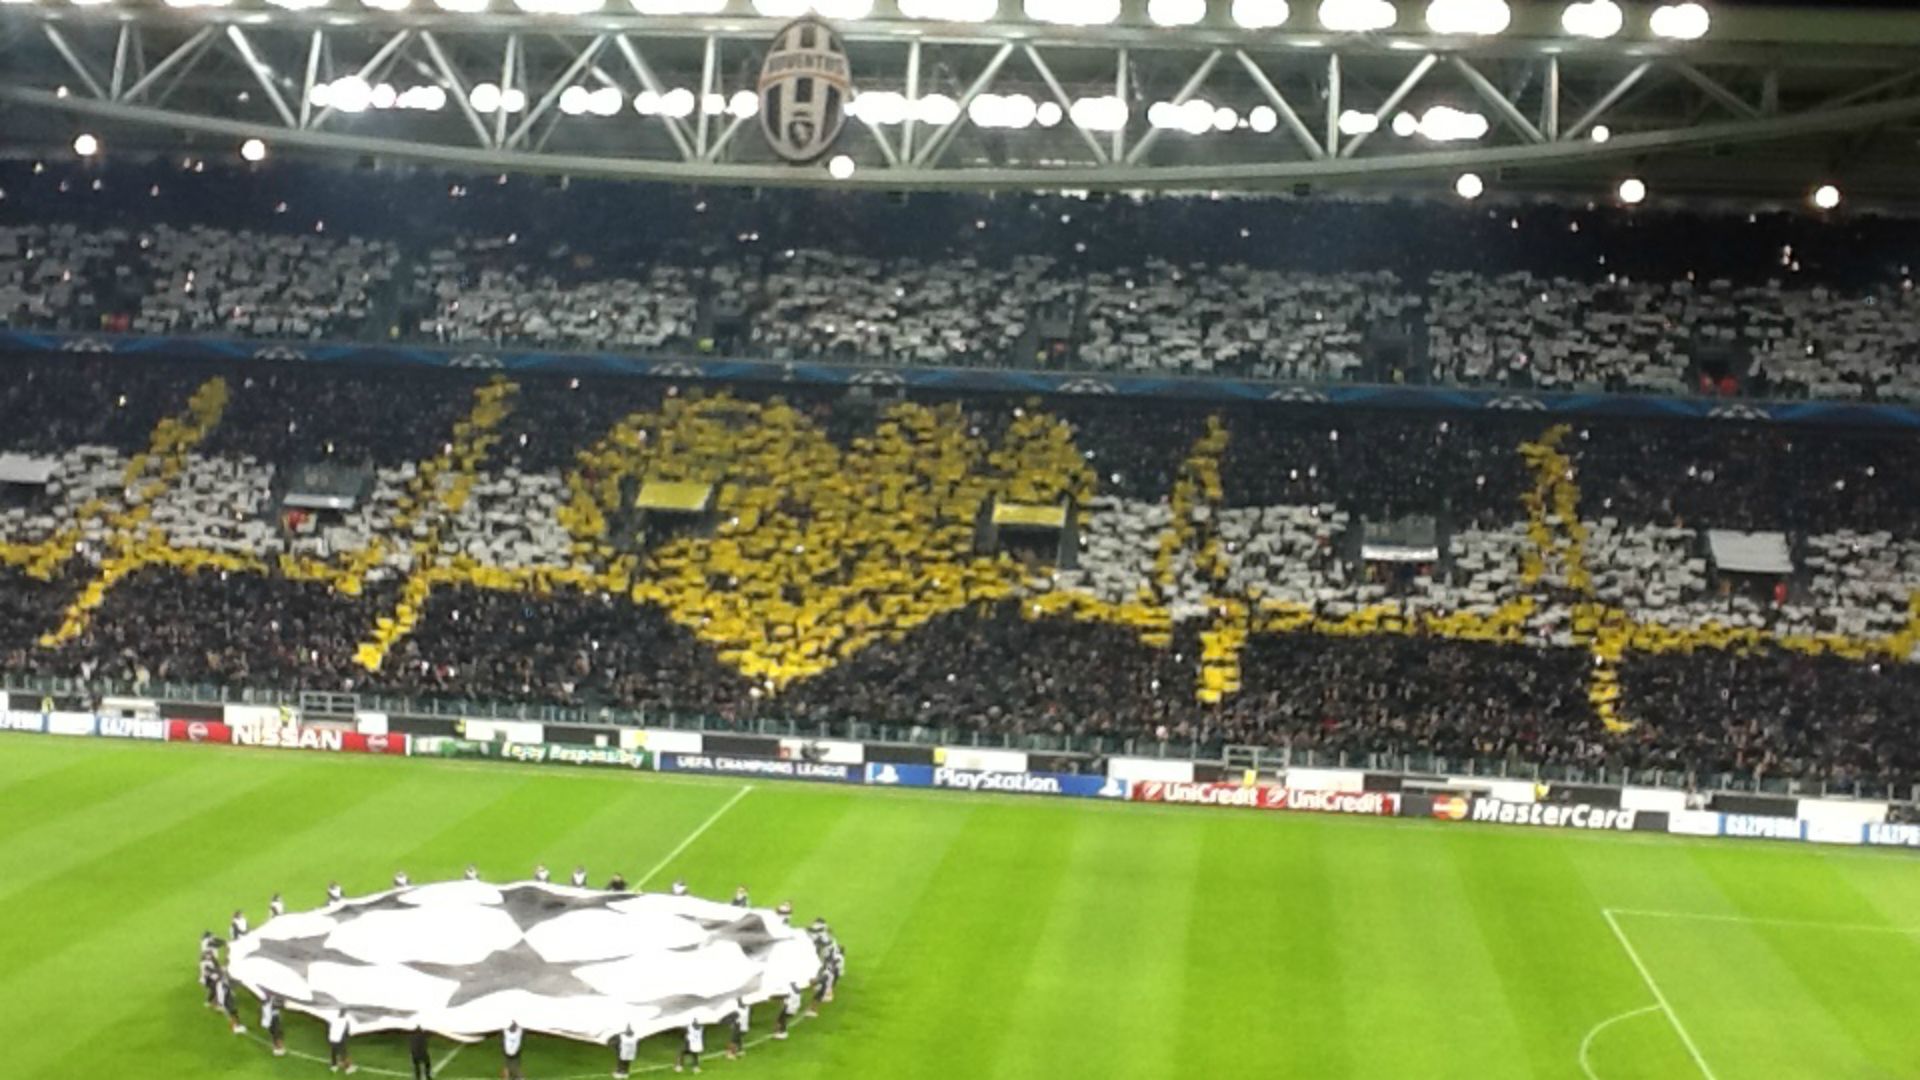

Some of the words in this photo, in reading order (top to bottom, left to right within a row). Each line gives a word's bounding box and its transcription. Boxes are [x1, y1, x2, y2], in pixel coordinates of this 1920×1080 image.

[232, 724, 343, 750] NISSAN
[550, 744, 643, 768] Responsibly
[676, 755, 713, 769] UEFA
[716, 757, 793, 775] CHAMPIONS
[797, 762, 847, 778] LEAGUE
[934, 767, 1058, 793] PlayStation
[1163, 783, 1258, 806] UniCredit
[1288, 788, 1384, 814] UniCredit
[1473, 798, 1636, 831] MasterCard
